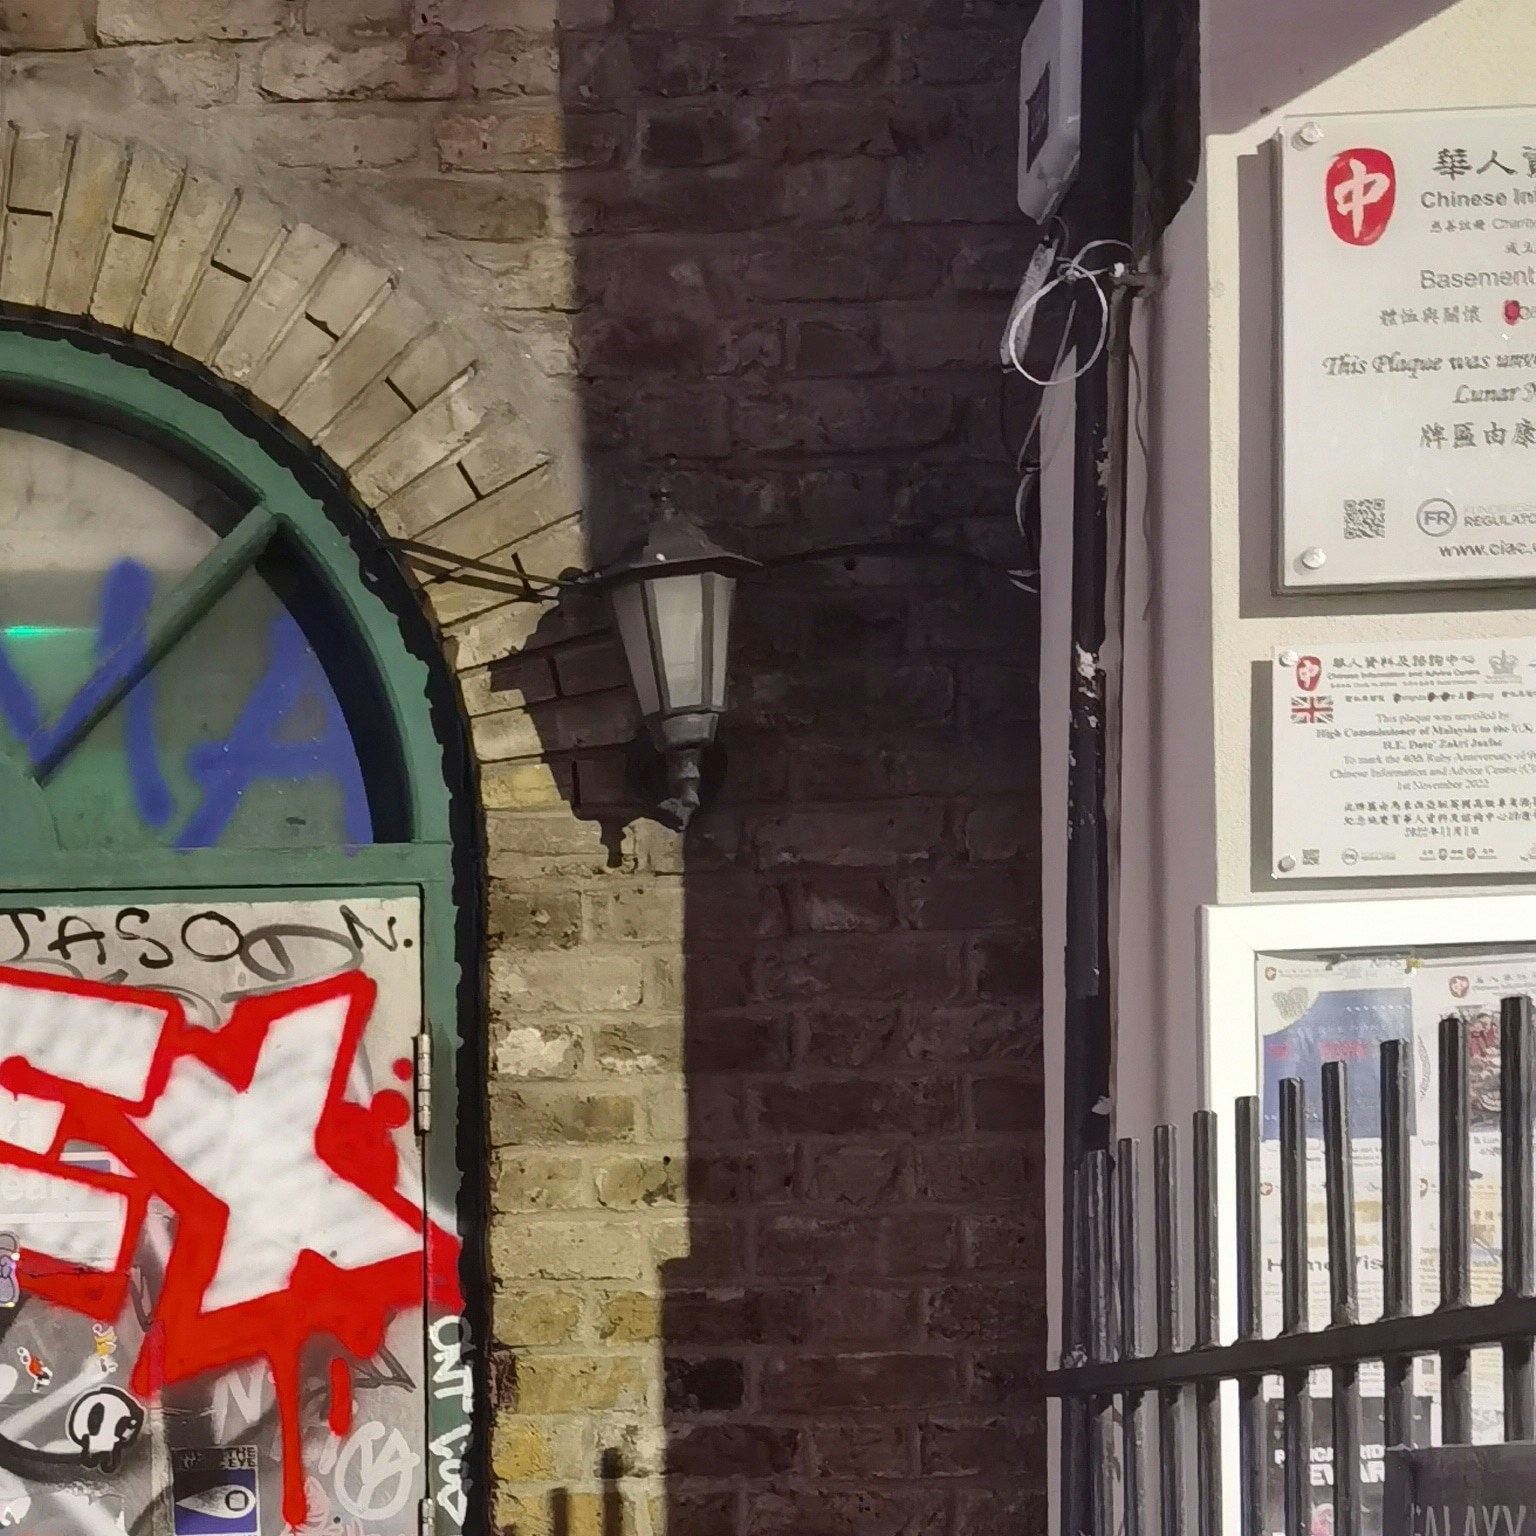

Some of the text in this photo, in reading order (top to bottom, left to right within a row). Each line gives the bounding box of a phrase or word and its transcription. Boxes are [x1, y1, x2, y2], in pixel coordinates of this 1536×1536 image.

[1333, 157, 1390, 240] 中
[1420, 190, 1508, 208] Chinese
[1420, 265, 1535, 290] Basement
[1321, 353, 1368, 376] This
[1372, 350, 1443, 379] Plaque
[1448, 354, 1491, 370] was
[1452, 384, 1521, 404] Lunar
[1424, 510, 1452, 526] FR
